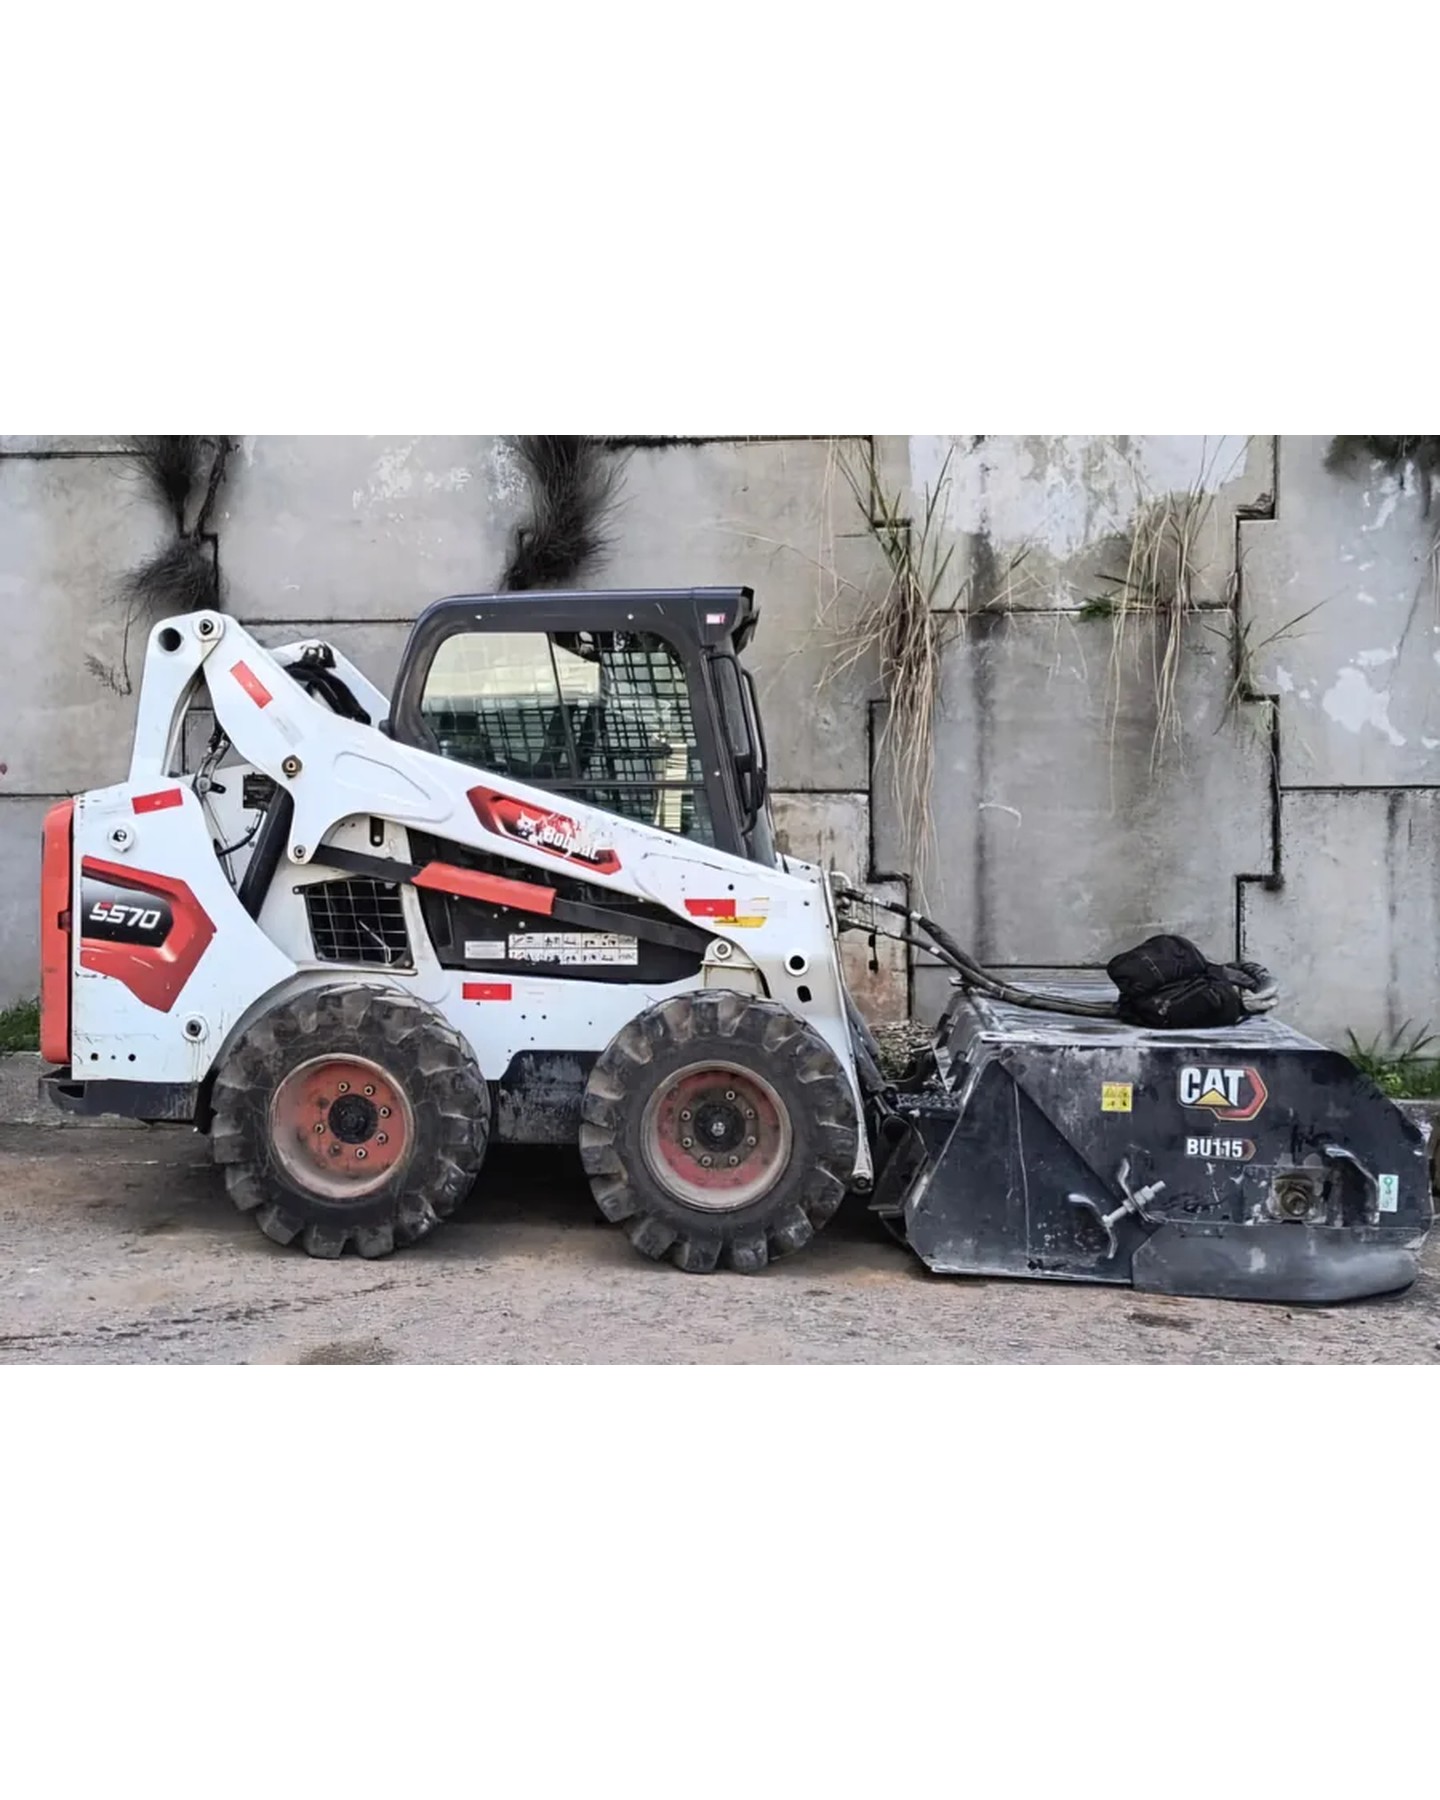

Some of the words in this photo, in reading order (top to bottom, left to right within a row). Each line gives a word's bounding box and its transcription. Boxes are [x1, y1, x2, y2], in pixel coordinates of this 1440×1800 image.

[542, 825, 599, 860] Bobat
[89, 901, 161, 929] S570
[1180, 1067, 1245, 1106] CAT
[1186, 1138, 1243, 1158] BU115
